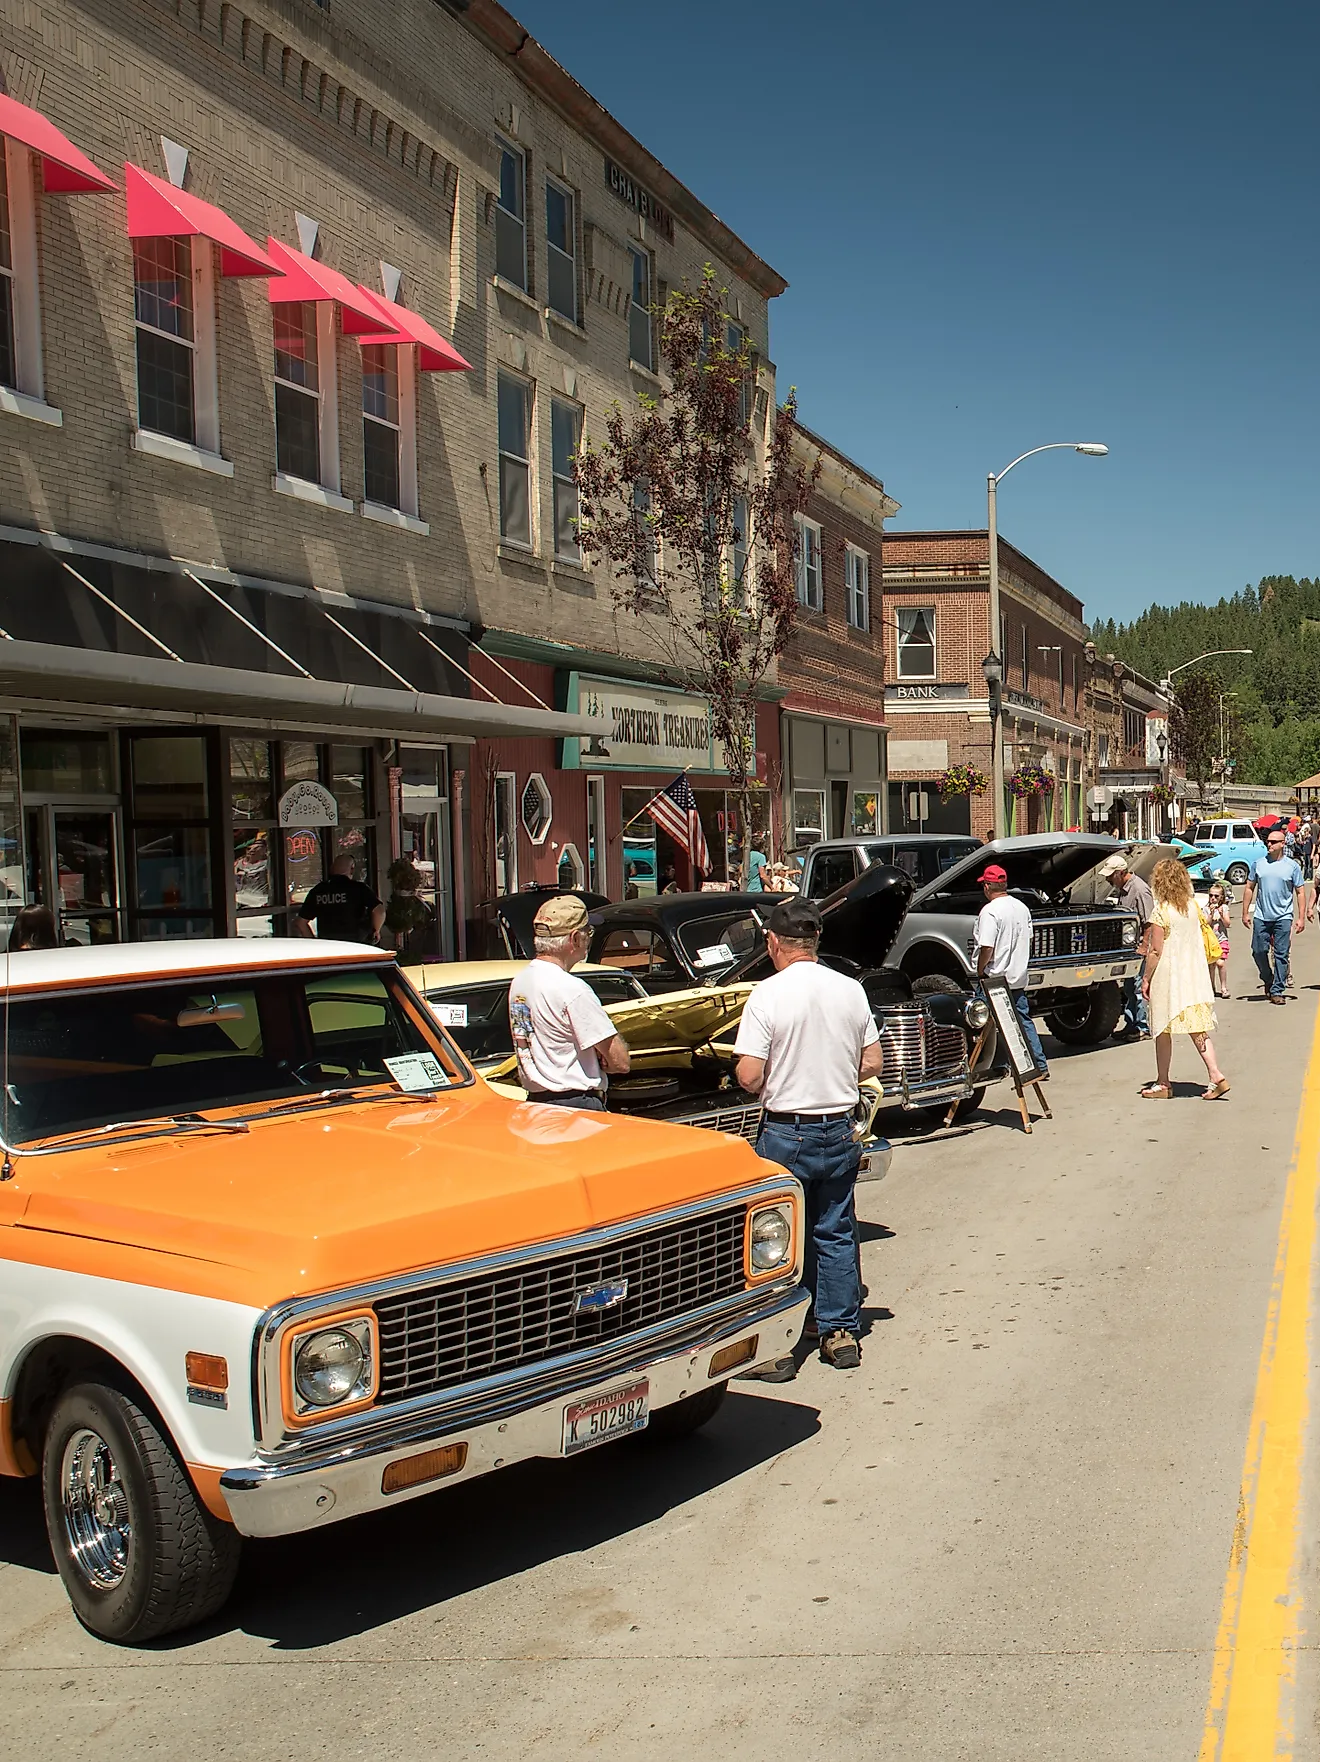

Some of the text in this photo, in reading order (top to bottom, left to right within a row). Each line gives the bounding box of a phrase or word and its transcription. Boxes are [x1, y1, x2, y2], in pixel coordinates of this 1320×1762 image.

[897, 686, 939, 699] BANK
[612, 706, 709, 750] NORTHERN TREASURES
[316, 892, 347, 905] POLICE
[595, 1390, 626, 1408] IDAHO
[571, 1419, 578, 1442] K
[590, 1396, 644, 1435] 502982
